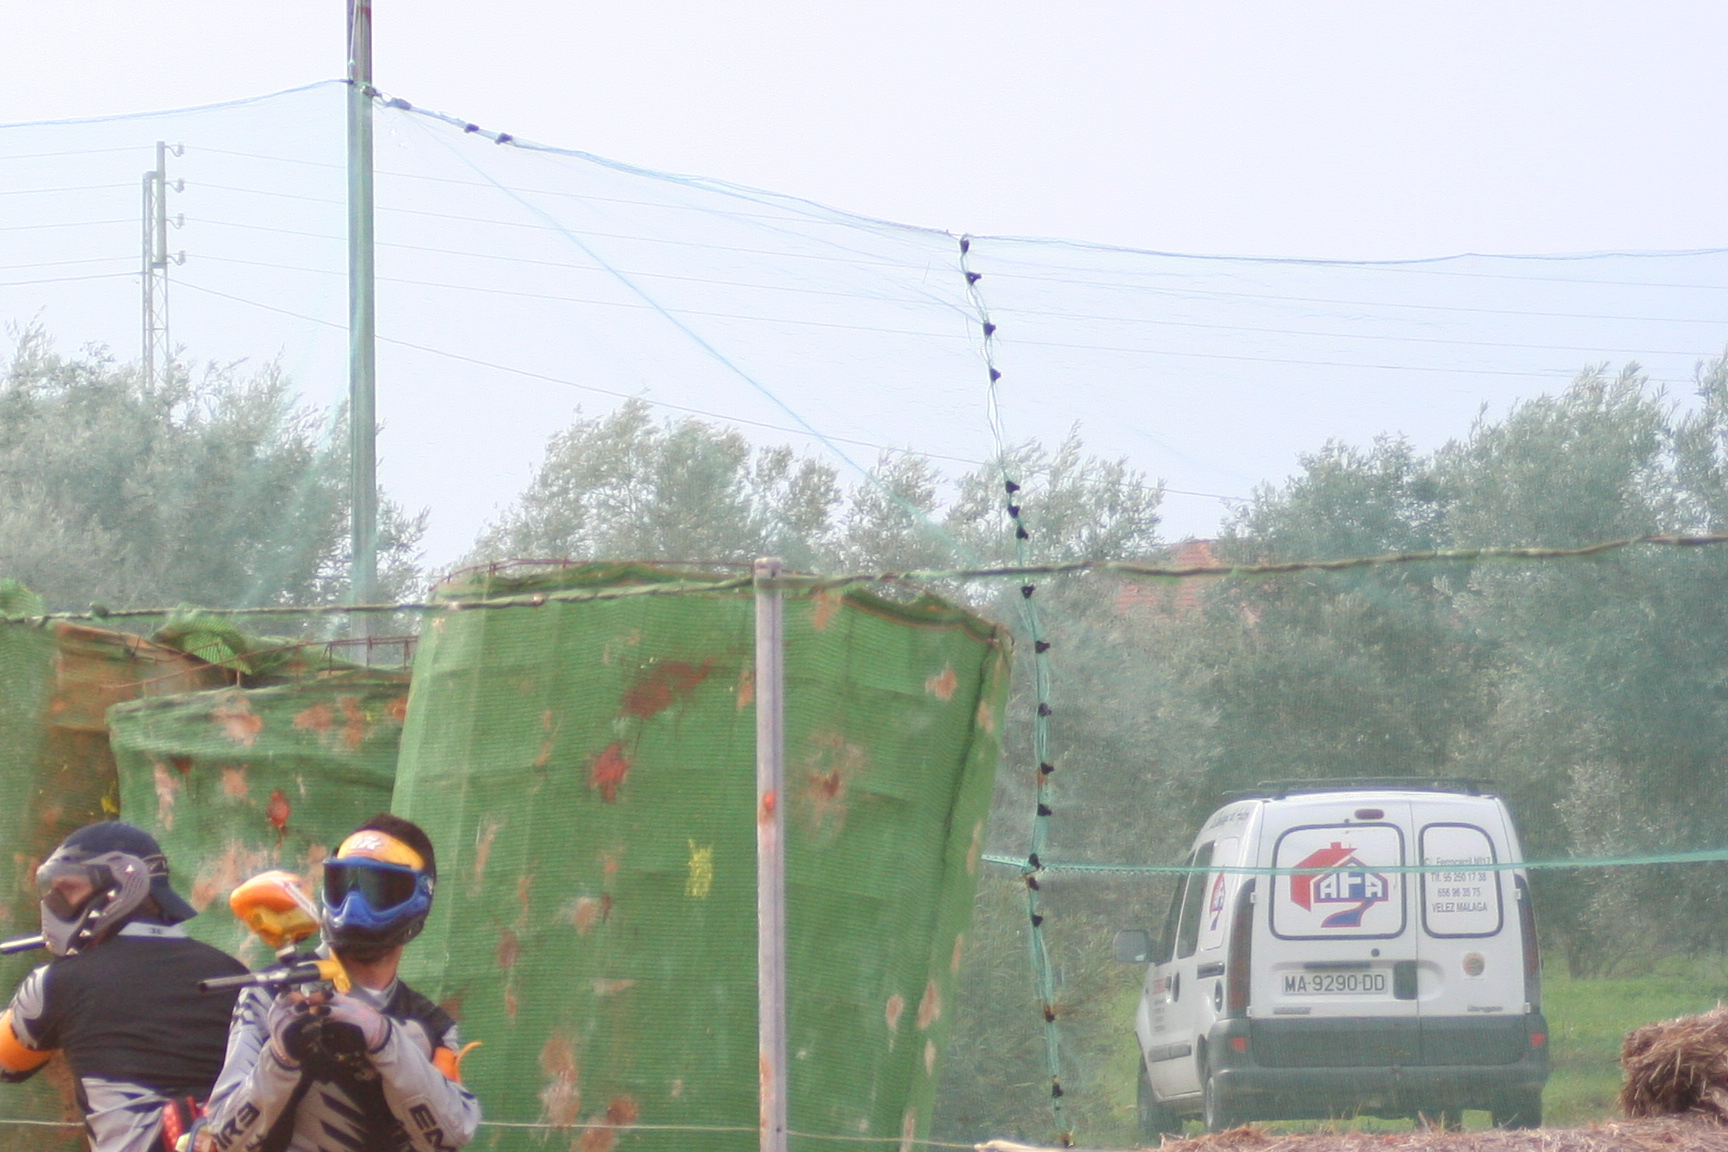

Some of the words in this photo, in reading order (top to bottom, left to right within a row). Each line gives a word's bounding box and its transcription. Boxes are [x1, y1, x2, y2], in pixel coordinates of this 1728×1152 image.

[1319, 866, 1383, 899] AFA
[1432, 902, 1456, 912] VELEZ
[1456, 902, 1487, 912] MALAGA
